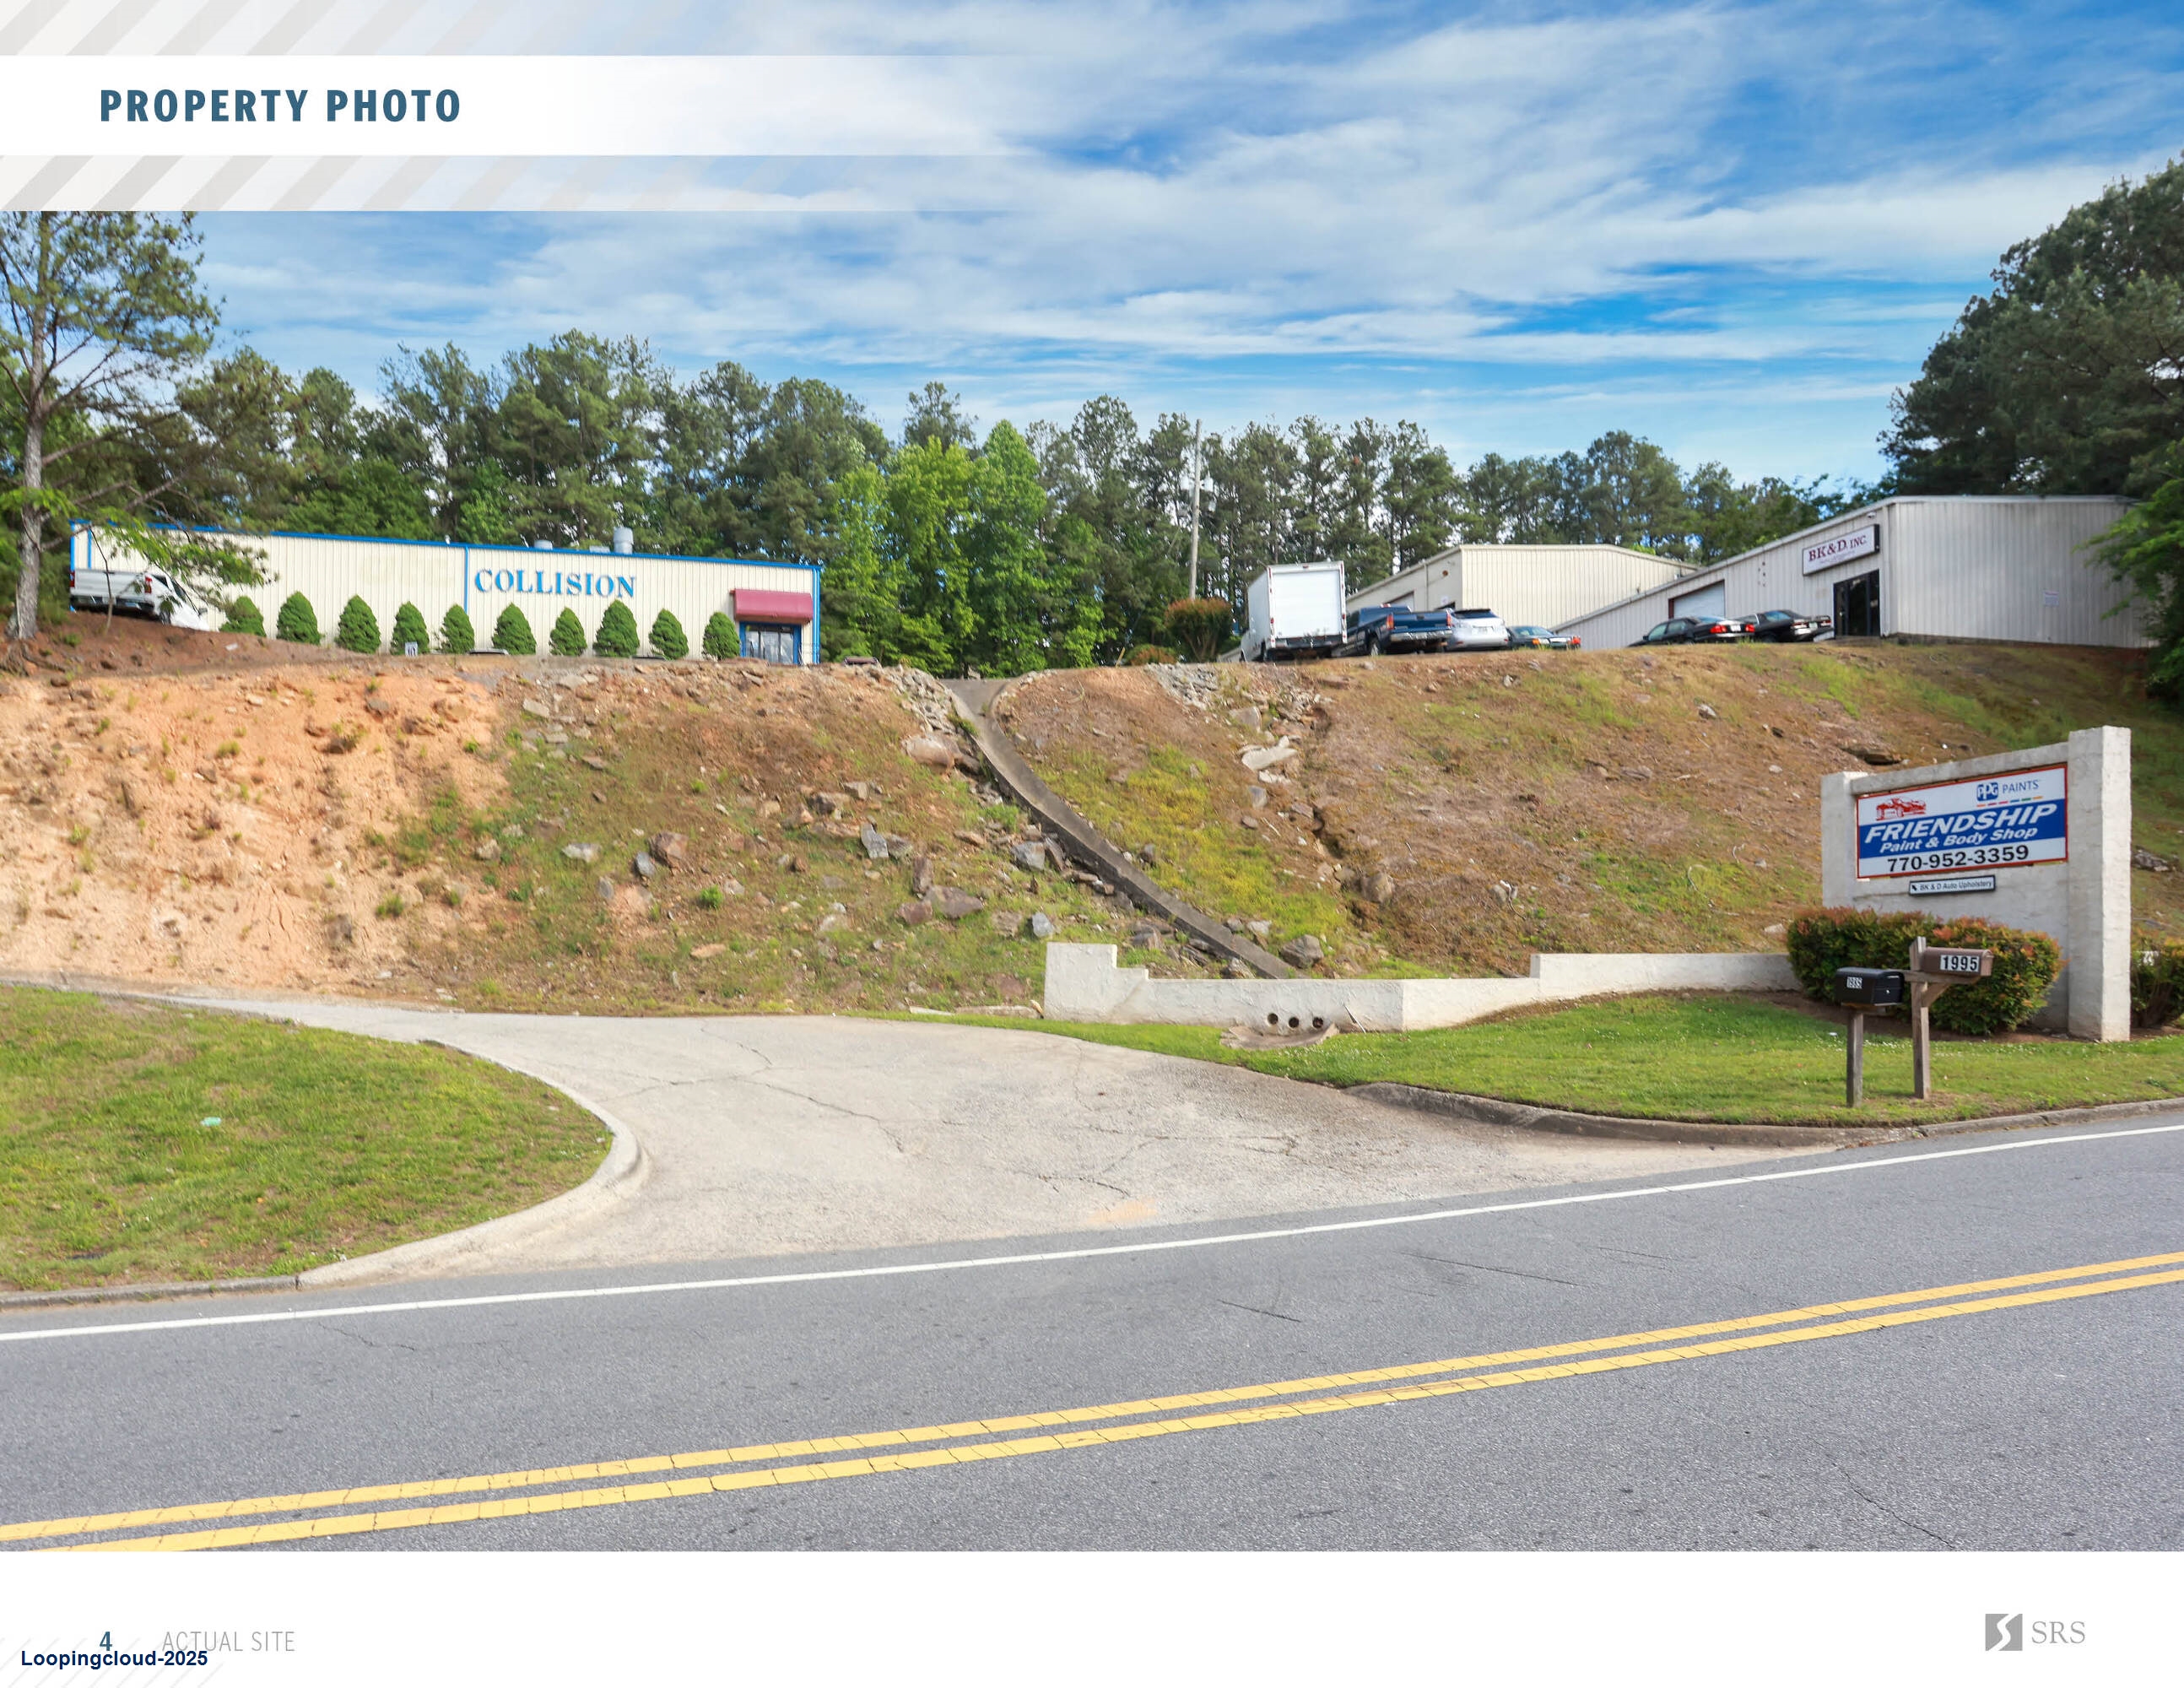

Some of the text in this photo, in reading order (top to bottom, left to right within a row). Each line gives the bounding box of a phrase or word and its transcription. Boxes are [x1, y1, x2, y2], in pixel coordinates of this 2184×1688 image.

[474, 568, 635, 598] COLLISION
[1978, 779, 2040, 800] PPG PAINTS
[1864, 803, 2057, 844] FRIENDSHIP
[1879, 827, 2038, 853] Paint & Body Shop
[1887, 844, 2030, 873] 770-952-3359
[1942, 955, 1979, 971] 1995
